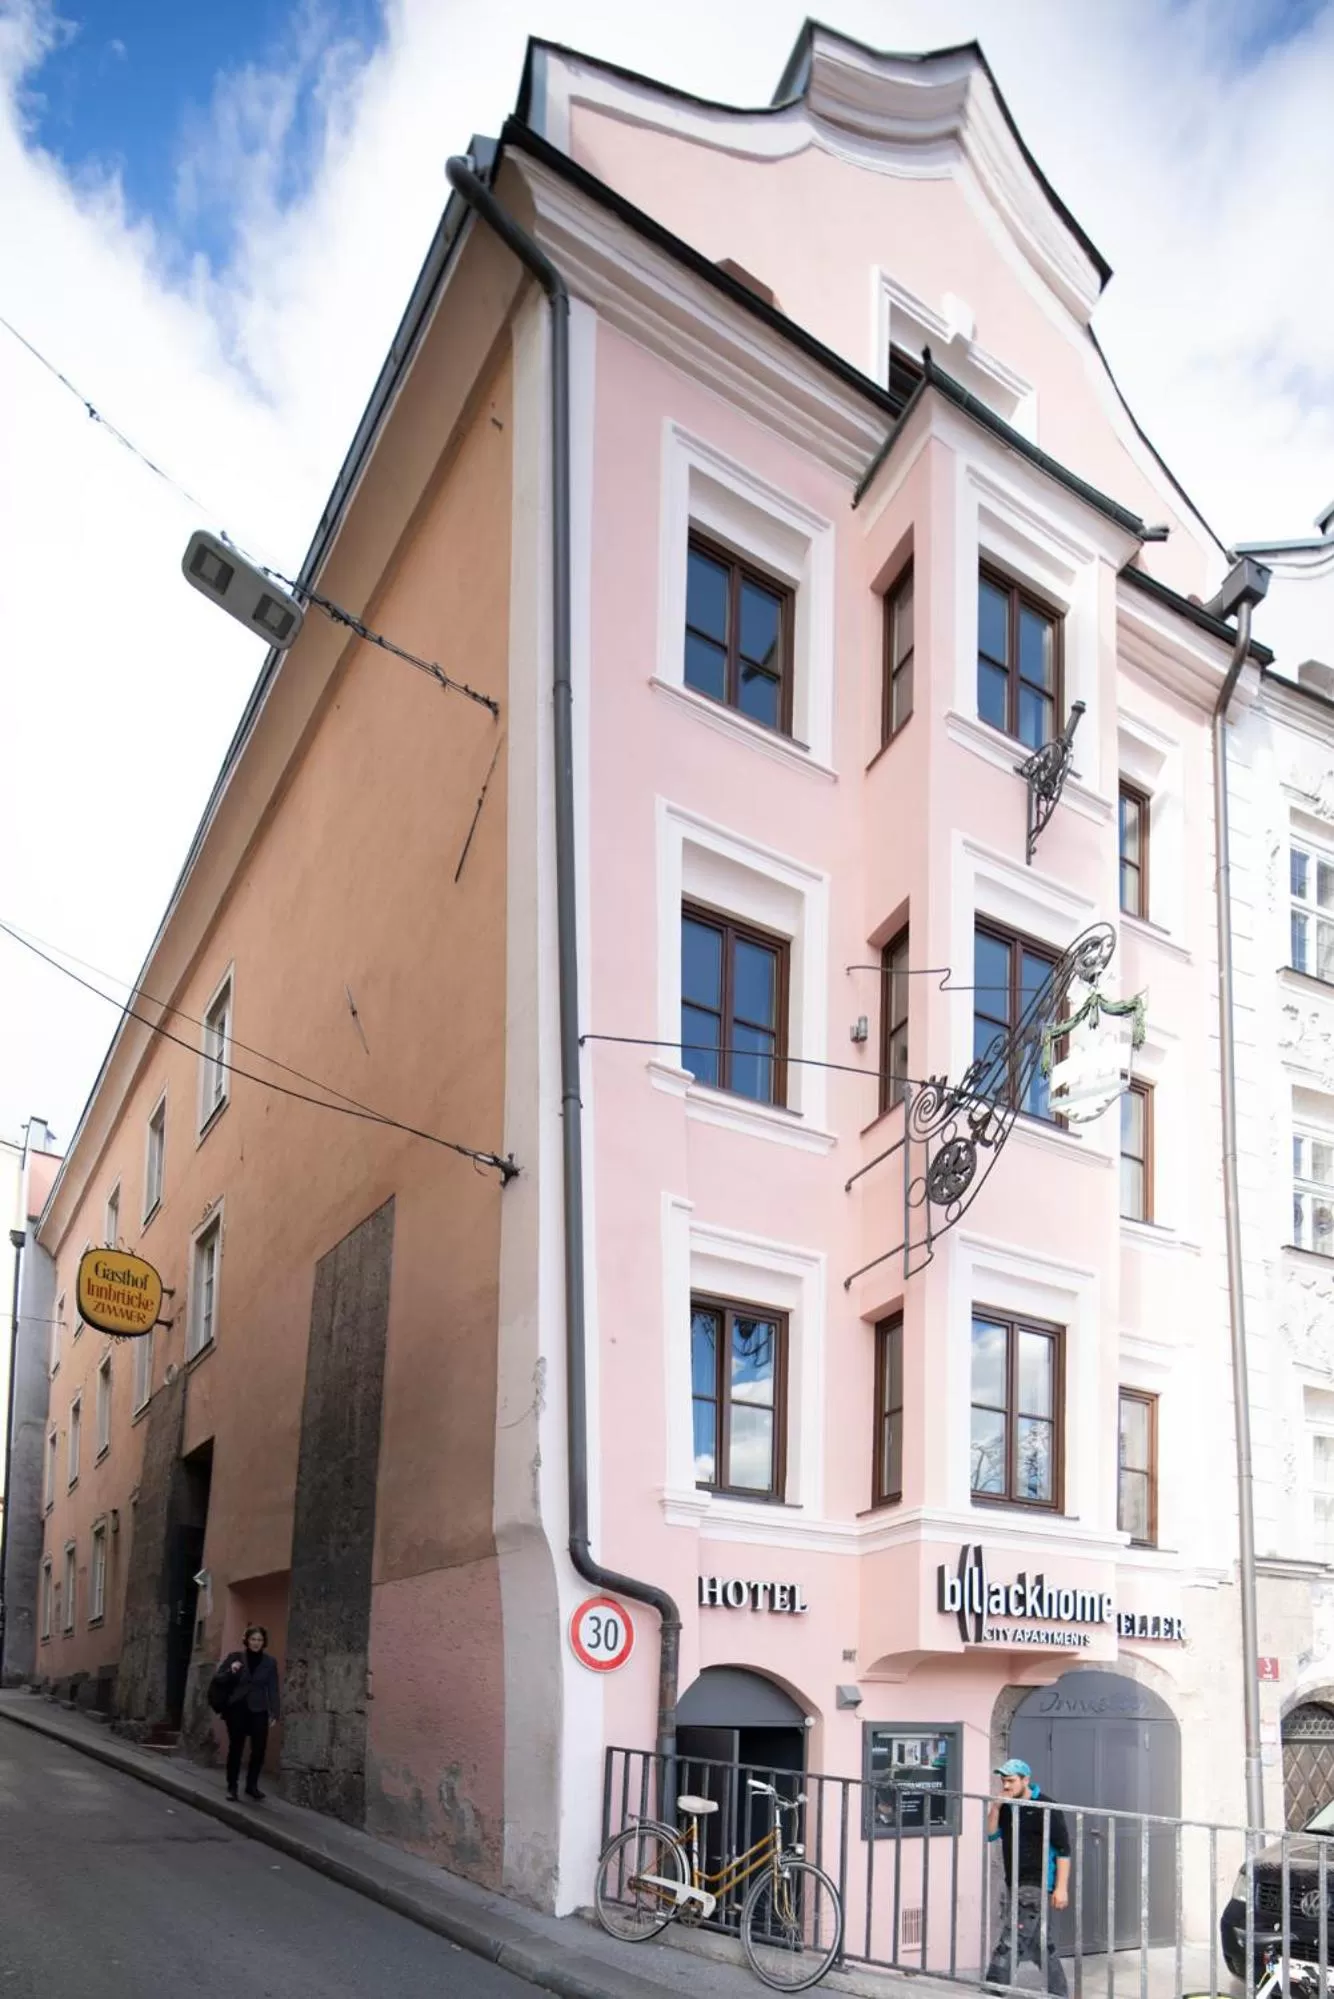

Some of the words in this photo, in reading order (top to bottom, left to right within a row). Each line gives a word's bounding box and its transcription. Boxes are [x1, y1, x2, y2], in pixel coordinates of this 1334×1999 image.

[94, 1260, 149, 1290] Gasthof
[93, 1301, 146, 1324] ZIMMER
[698, 1576, 808, 1614] HOTEL
[587, 1616, 618, 1650] 30
[984, 1627, 1010, 1641] CITY
[1012, 1628, 1091, 1646] APARTMENTS
[1117, 1613, 1185, 1640] ELLER
